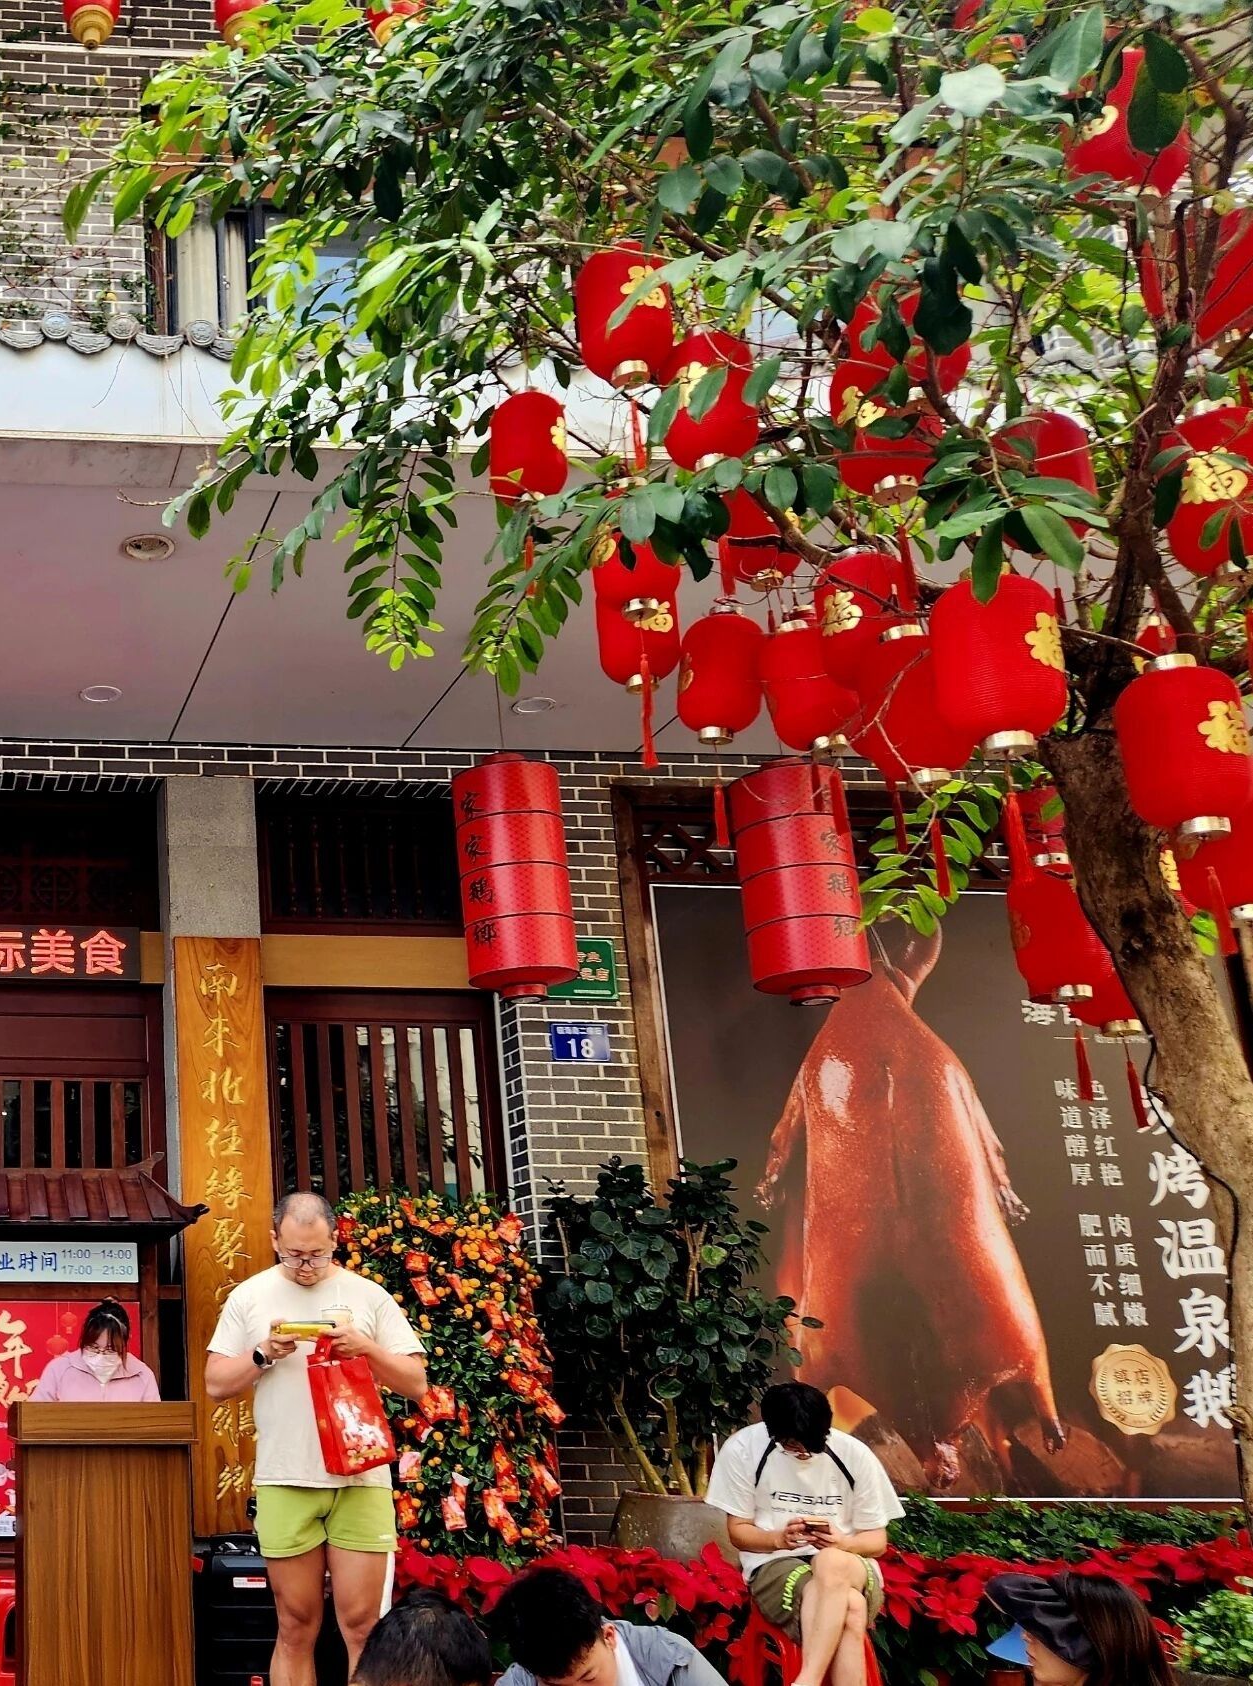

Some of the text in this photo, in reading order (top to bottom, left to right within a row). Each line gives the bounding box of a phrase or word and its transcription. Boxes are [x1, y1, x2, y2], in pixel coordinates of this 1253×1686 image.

[567, 1038, 595, 1058] 18
[1078, 1213, 1120, 1327] 肥而不腻
[1108, 1213, 1150, 1327] 肉质细嫩
